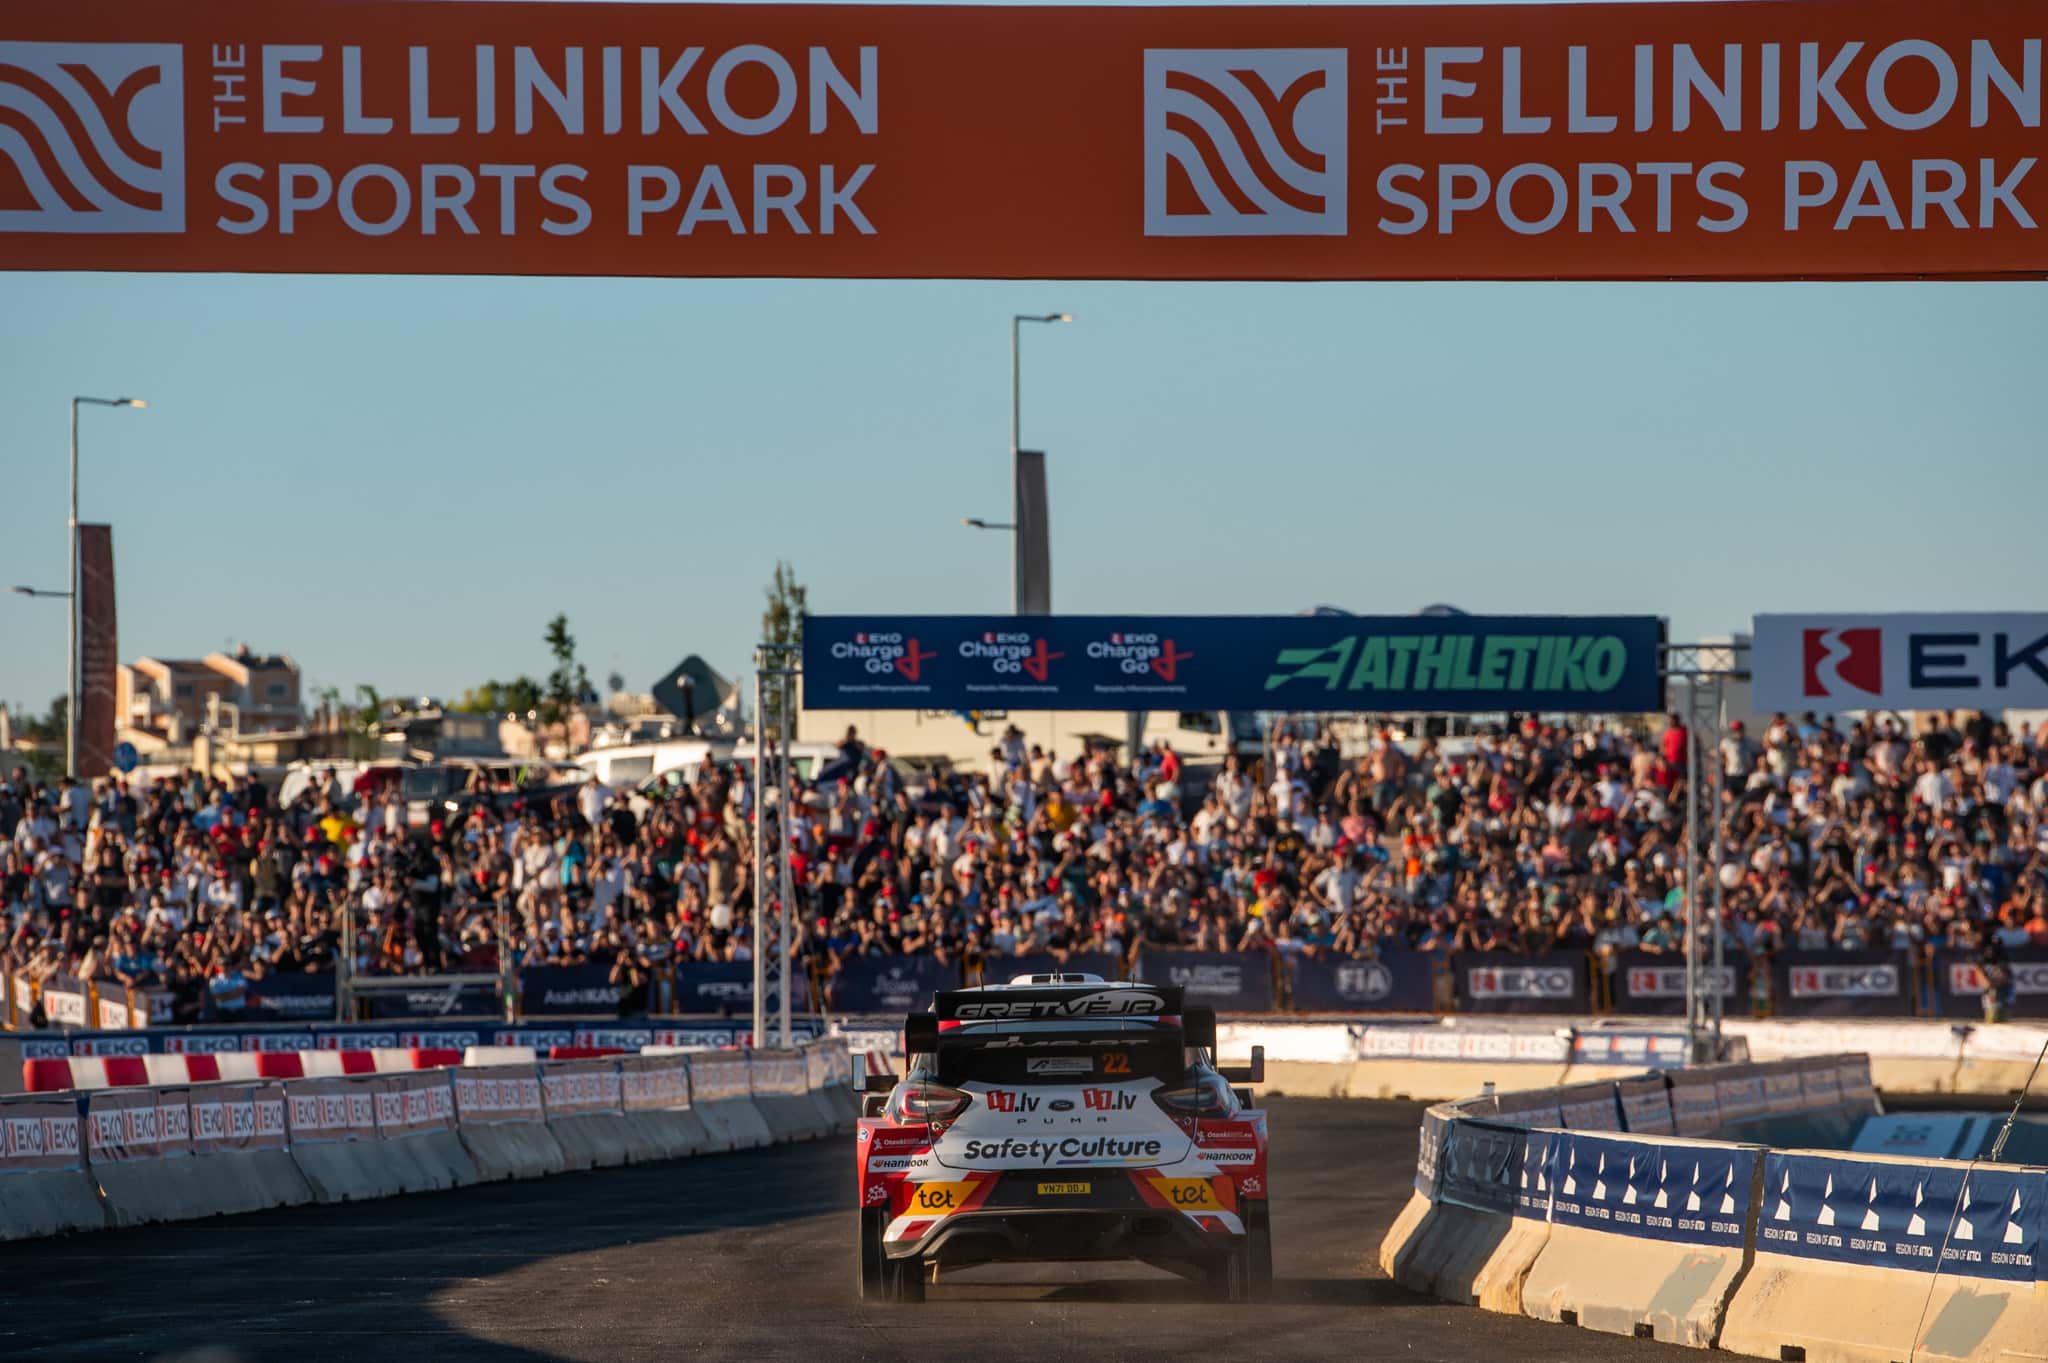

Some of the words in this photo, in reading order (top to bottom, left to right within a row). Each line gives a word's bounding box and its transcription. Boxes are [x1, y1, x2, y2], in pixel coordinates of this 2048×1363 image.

[213, 44, 246, 133] THE
[262, 44, 879, 136] ELLINIKON
[1377, 46, 1408, 135] THE
[1424, 38, 2043, 135] ELLINIKON
[214, 162, 593, 237] SPORTS
[627, 164, 878, 237] PARK
[1376, 160, 1749, 236] SPORTS
[1784, 158, 2040, 231] PARK
[869, 633, 902, 643] EKO
[996, 633, 1029, 643] EKO
[1124, 633, 1158, 644] EKO
[831, 642, 904, 660] Charge
[959, 641, 1031, 660] Charge
[1087, 642, 1160, 660] Charge
[865, 658, 894, 673] Go
[993, 658, 1022, 673] Go
[1120, 658, 1149, 674] Go
[1347, 635, 1627, 692] ATHLETIKO
[1337, 967, 1388, 992] FIA
[1502, 973, 1569, 992] EKO
[1824, 971, 1895, 990] EKO
[96, 1040, 146, 1055] EKO
[187, 1036, 237, 1051] EKO
[265, 1036, 310, 1050] EKO
[341, 1034, 394, 1048] EKO
[594, 1031, 648, 1047] EKO
[678, 1031, 729, 1045] EKO
[1103, 1053, 1132, 1073] 22
[134, 1111, 155, 1139] EKO
[167, 1108, 188, 1135] EKO
[204, 1109, 223, 1133] EKO
[234, 1107, 254, 1132] EKO
[17, 1124, 42, 1150] EKO
[54, 1122, 78, 1148] EKO
[964, 1137, 1161, 1165] SafetyCulture
[1043, 1184, 1064, 1194] YN71
[1171, 1183, 1208, 1204] tet
[918, 1189, 955, 1209] tet
